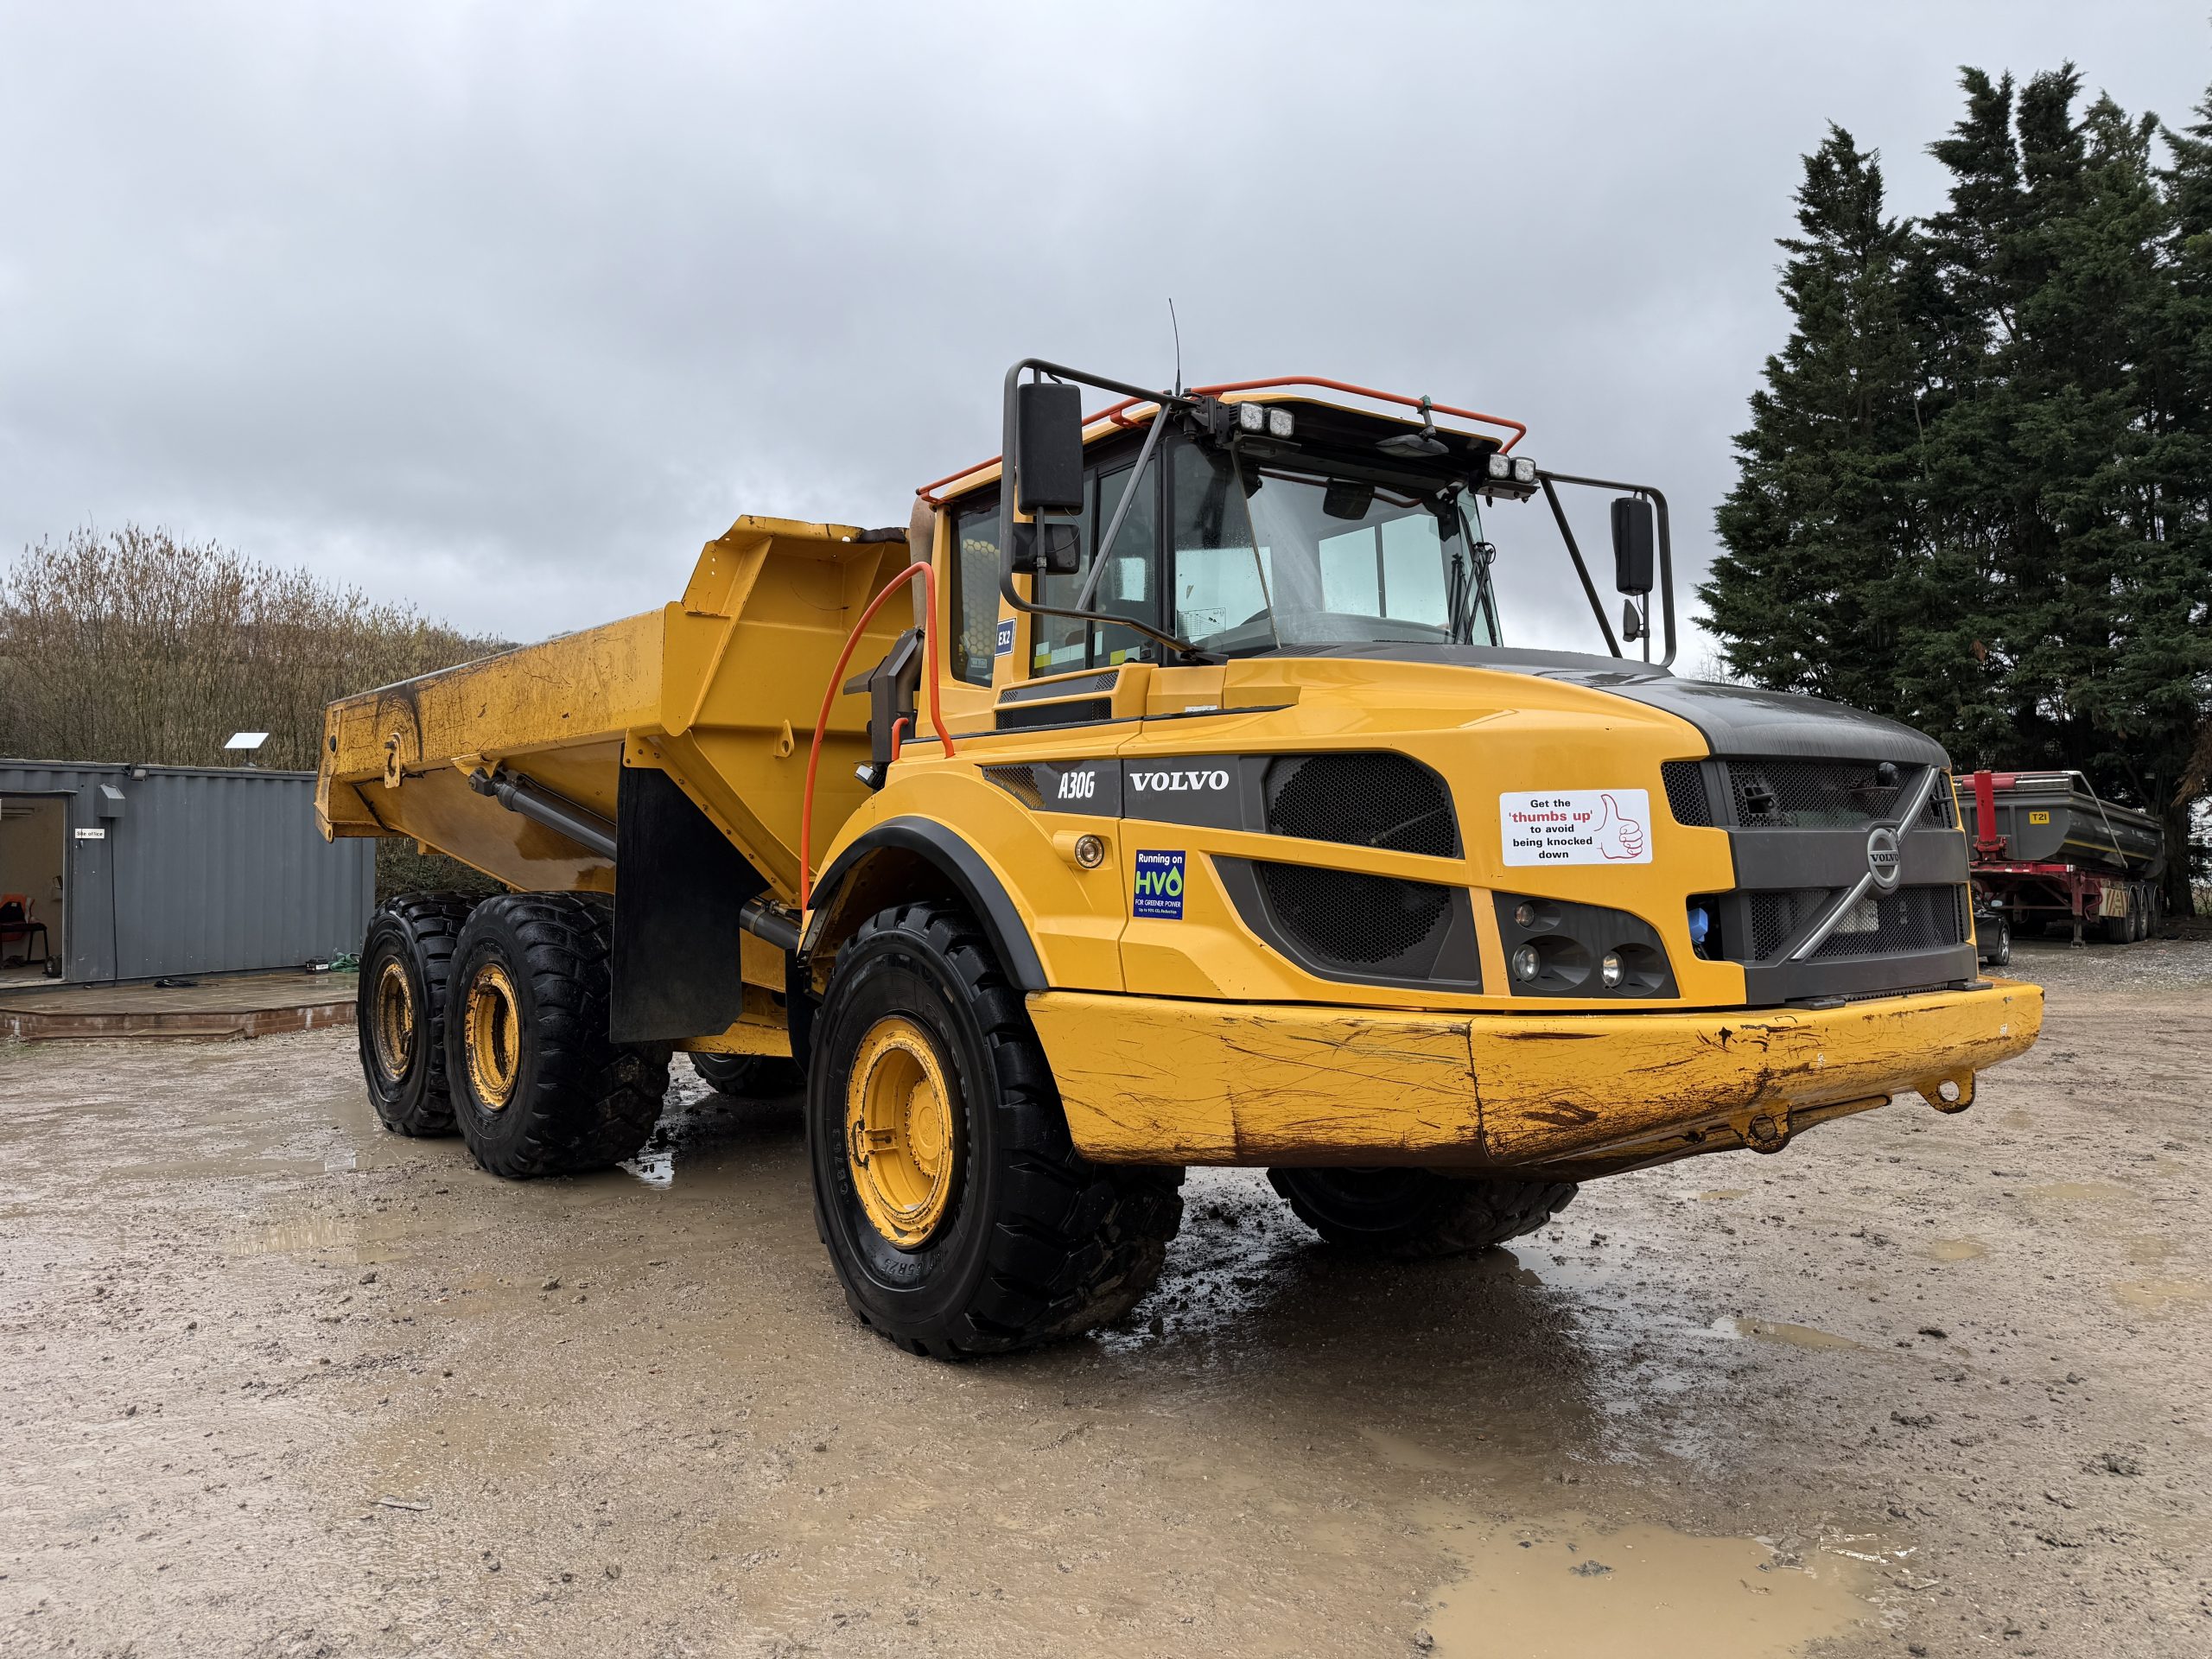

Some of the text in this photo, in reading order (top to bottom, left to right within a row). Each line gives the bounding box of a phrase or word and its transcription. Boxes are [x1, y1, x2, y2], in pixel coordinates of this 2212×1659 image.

[998, 630, 1011, 646] EX2
[1058, 771, 1096, 799] A30G
[1129, 770, 1230, 791] VOLVO
[1530, 798, 1571, 808] Get the
[1509, 810, 1593, 823] 'thumbs up'
[1530, 824, 1574, 834] to avoid
[1513, 836, 1593, 848] being knocked
[1139, 854, 1170, 866] Running
[1538, 850, 1569, 859] down
[1870, 854, 1899, 862] VOLVO
[1135, 865, 1183, 897] HVO
